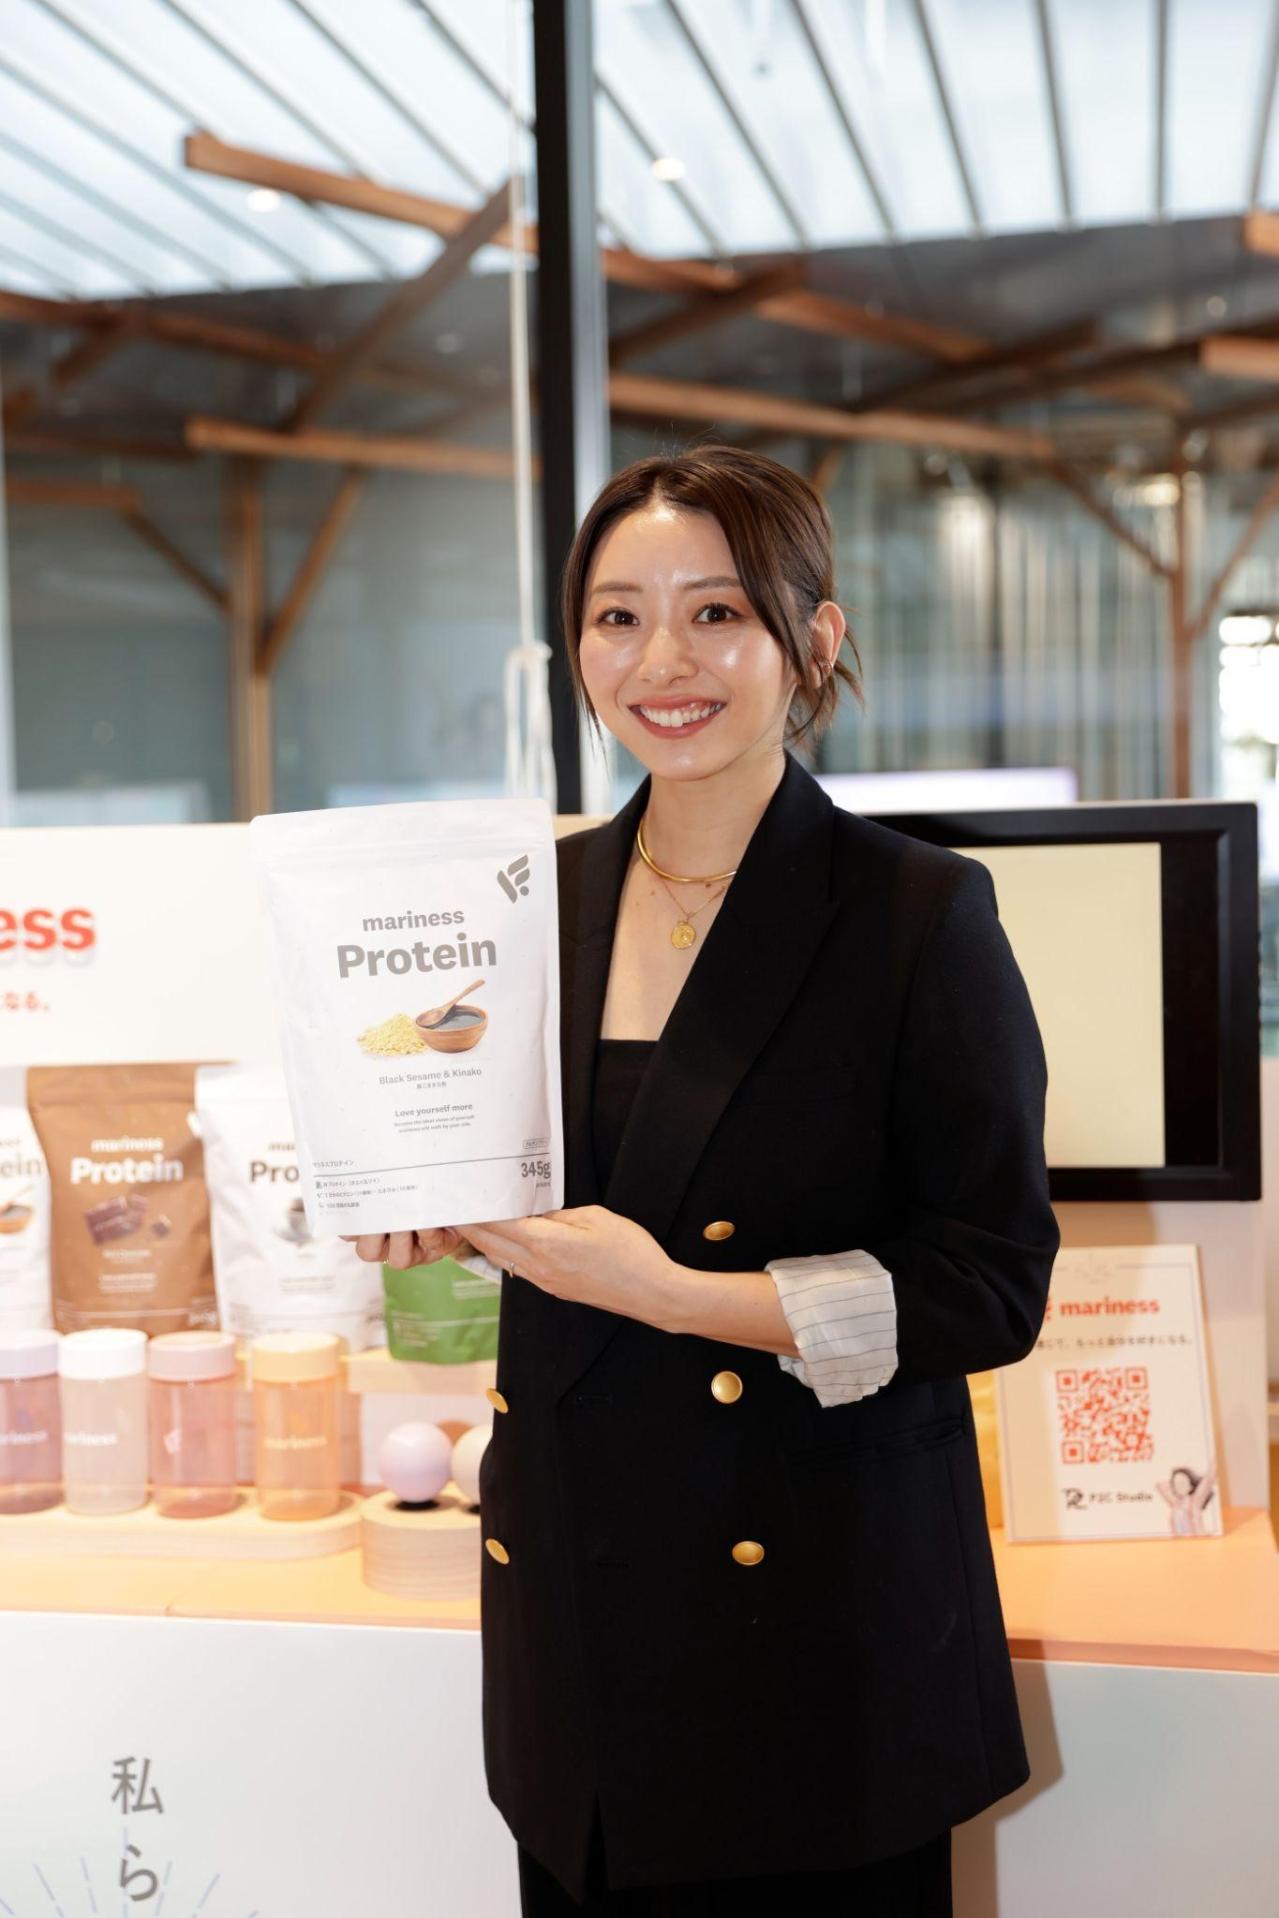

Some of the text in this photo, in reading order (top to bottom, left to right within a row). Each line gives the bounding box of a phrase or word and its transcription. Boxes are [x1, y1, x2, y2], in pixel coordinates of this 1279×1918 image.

[363, 910, 465, 931] mariness
[337, 932, 497, 978] Protein
[379, 1067, 482, 1085] Black Sesame & Kinako
[394, 1103, 473, 1118] Love yourself more
[91, 1135, 164, 1152] mariness
[70, 1154, 184, 1184] Protein
[521, 1160, 551, 1179] 345g
[1059, 1296, 1161, 1316] mariness
[111, 1756, 164, 1902] 私ら
